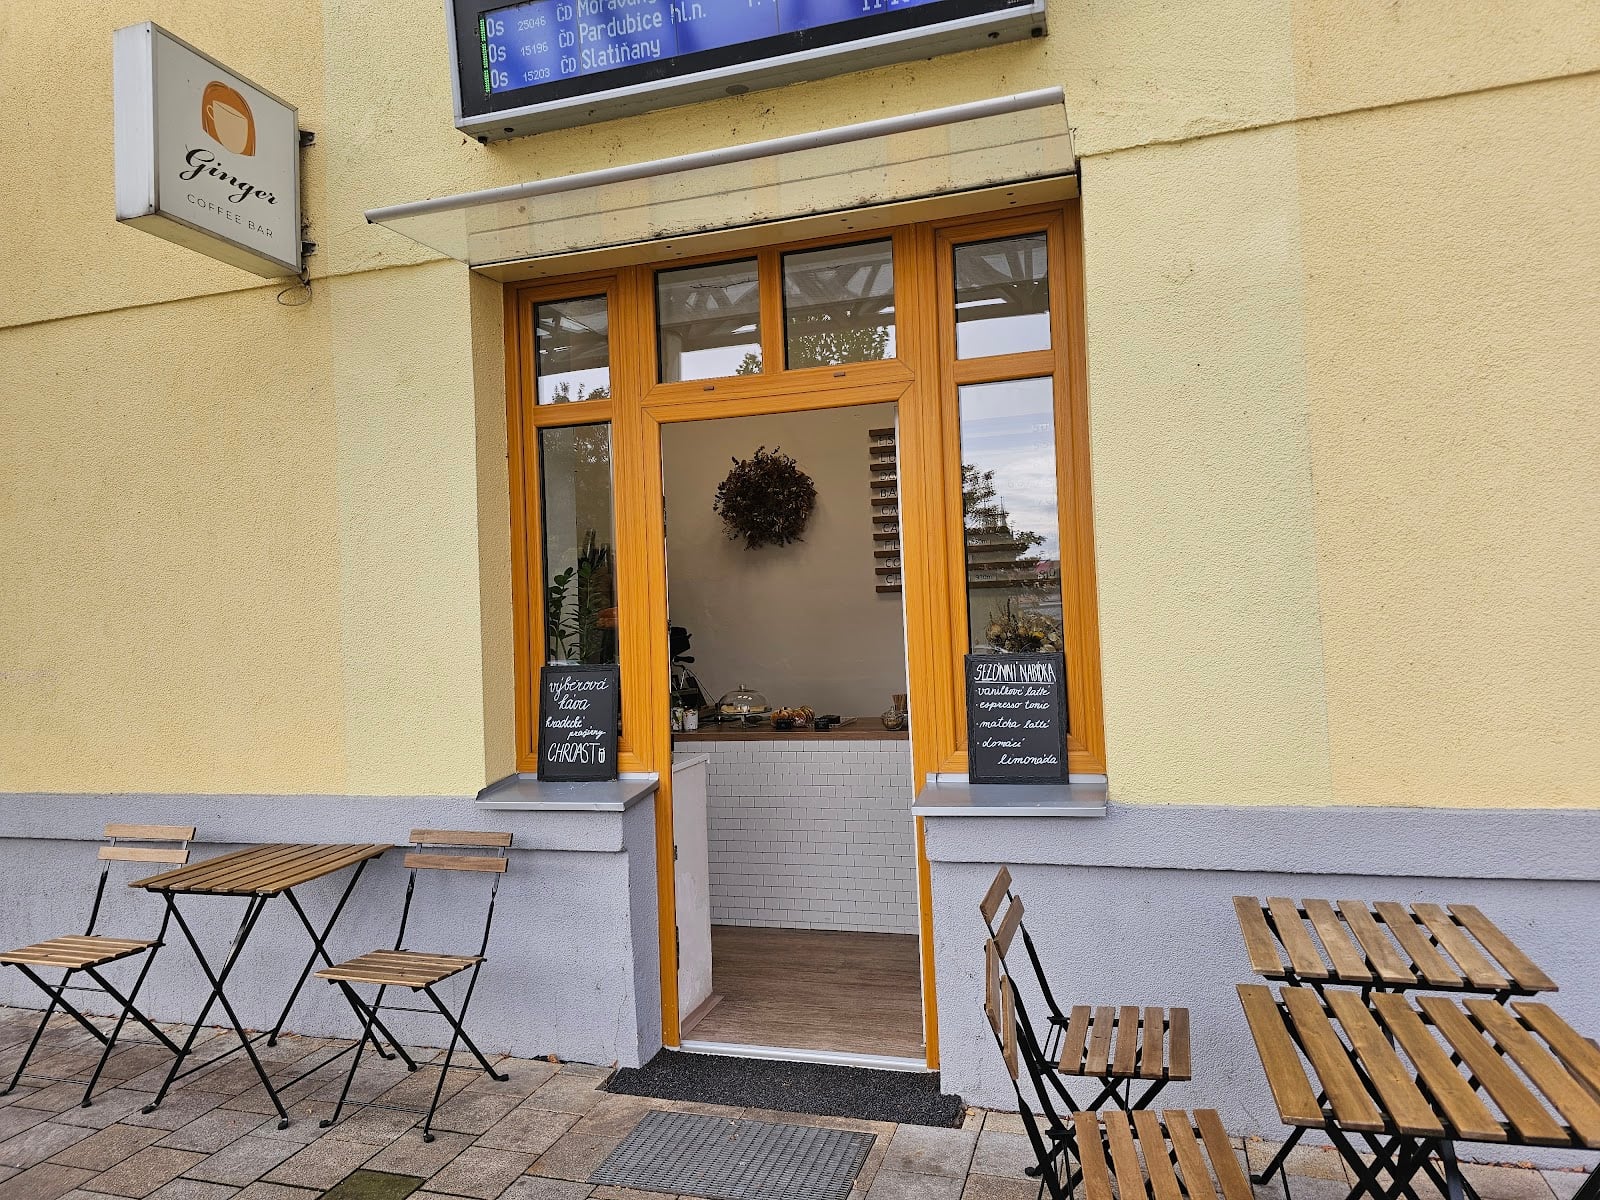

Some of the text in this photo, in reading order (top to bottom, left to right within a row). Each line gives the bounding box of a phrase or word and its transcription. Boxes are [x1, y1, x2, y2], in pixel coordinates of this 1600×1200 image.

[556, 3, 573, 22] ČD
[520, 42, 549, 57] 15196
[558, 29, 575, 48] ČD
[579, 11, 663, 44] Pardubice
[670, 1, 707, 25] hl.n.
[523, 67, 551, 82] 15203
[560, 55, 577, 74] ČD
[581, 39, 661, 70] Slatiňany
[179, 144, 278, 205] Ginger
[187, 194, 273, 239] COFFEE BAR
[558, 694, 591, 711] káva
[979, 700, 1050, 712] espresso tonic
[979, 716, 1021, 729] matcha
[982, 737, 1026, 748] domácí
[547, 742, 601, 765] CHROAST
[998, 753, 1058, 765] limonáda
